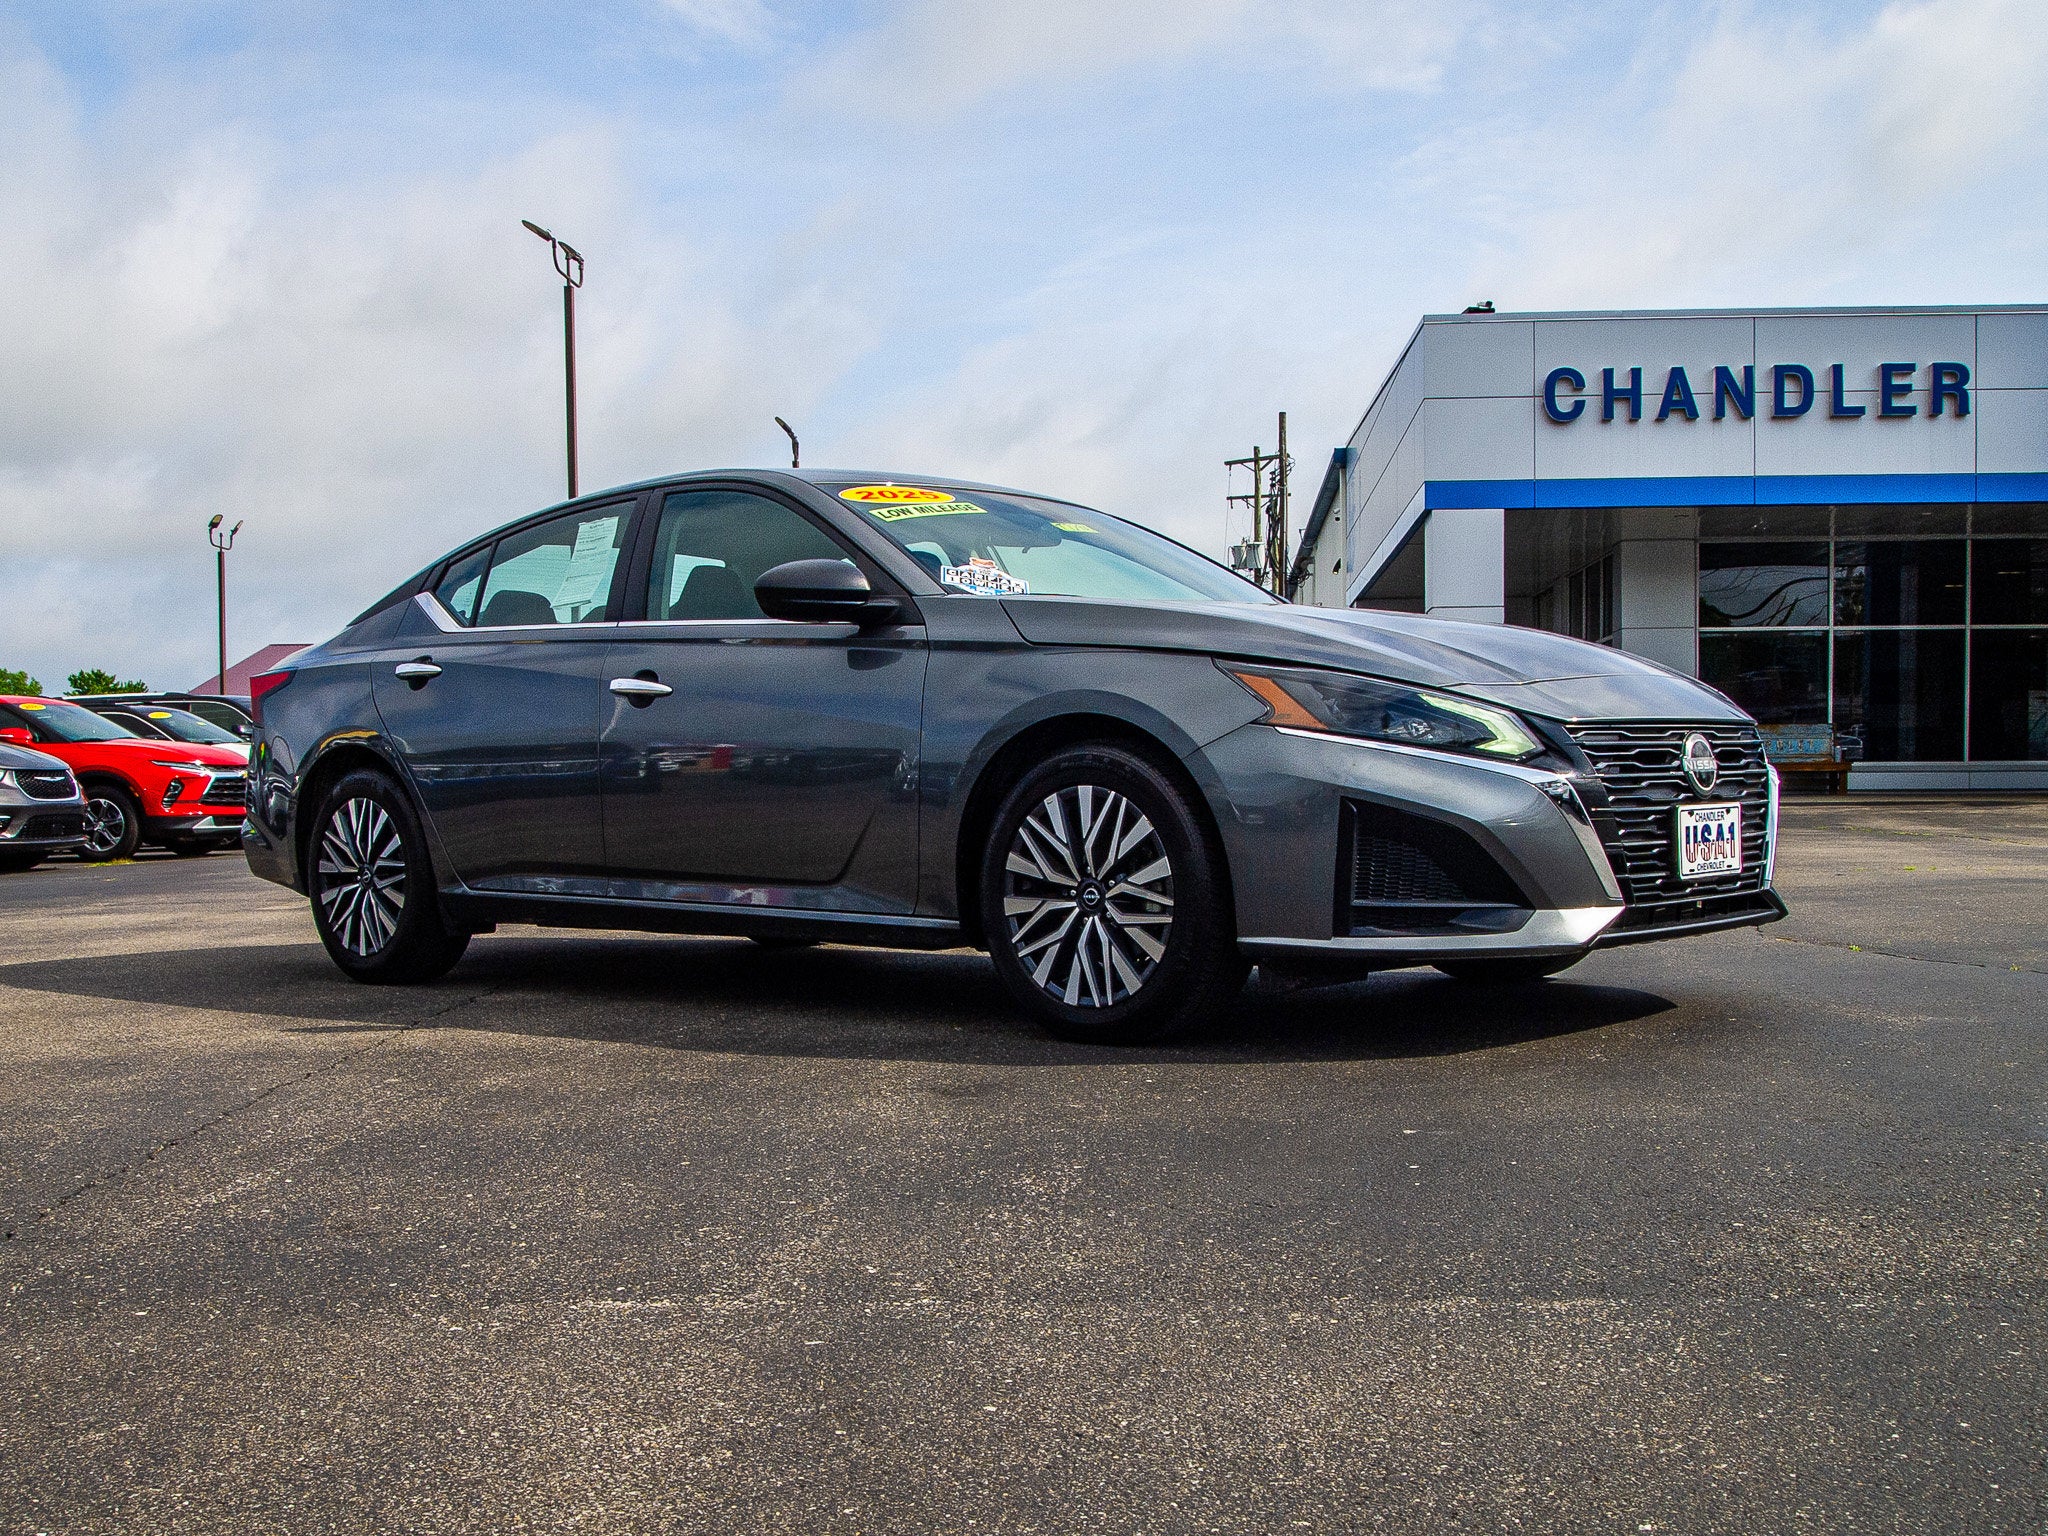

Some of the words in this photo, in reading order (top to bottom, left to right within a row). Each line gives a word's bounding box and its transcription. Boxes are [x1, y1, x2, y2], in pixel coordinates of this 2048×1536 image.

[1543, 361, 1972, 422] CHANDLER
[855, 490, 940, 500] 2025
[878, 507, 915, 519] LOW
[913, 503, 979, 515] MILEAGE
[1684, 759, 1718, 771] NISSA
[1695, 810, 1725, 822] CHANDLER
[1697, 860, 1726, 871] CHEVROLET
